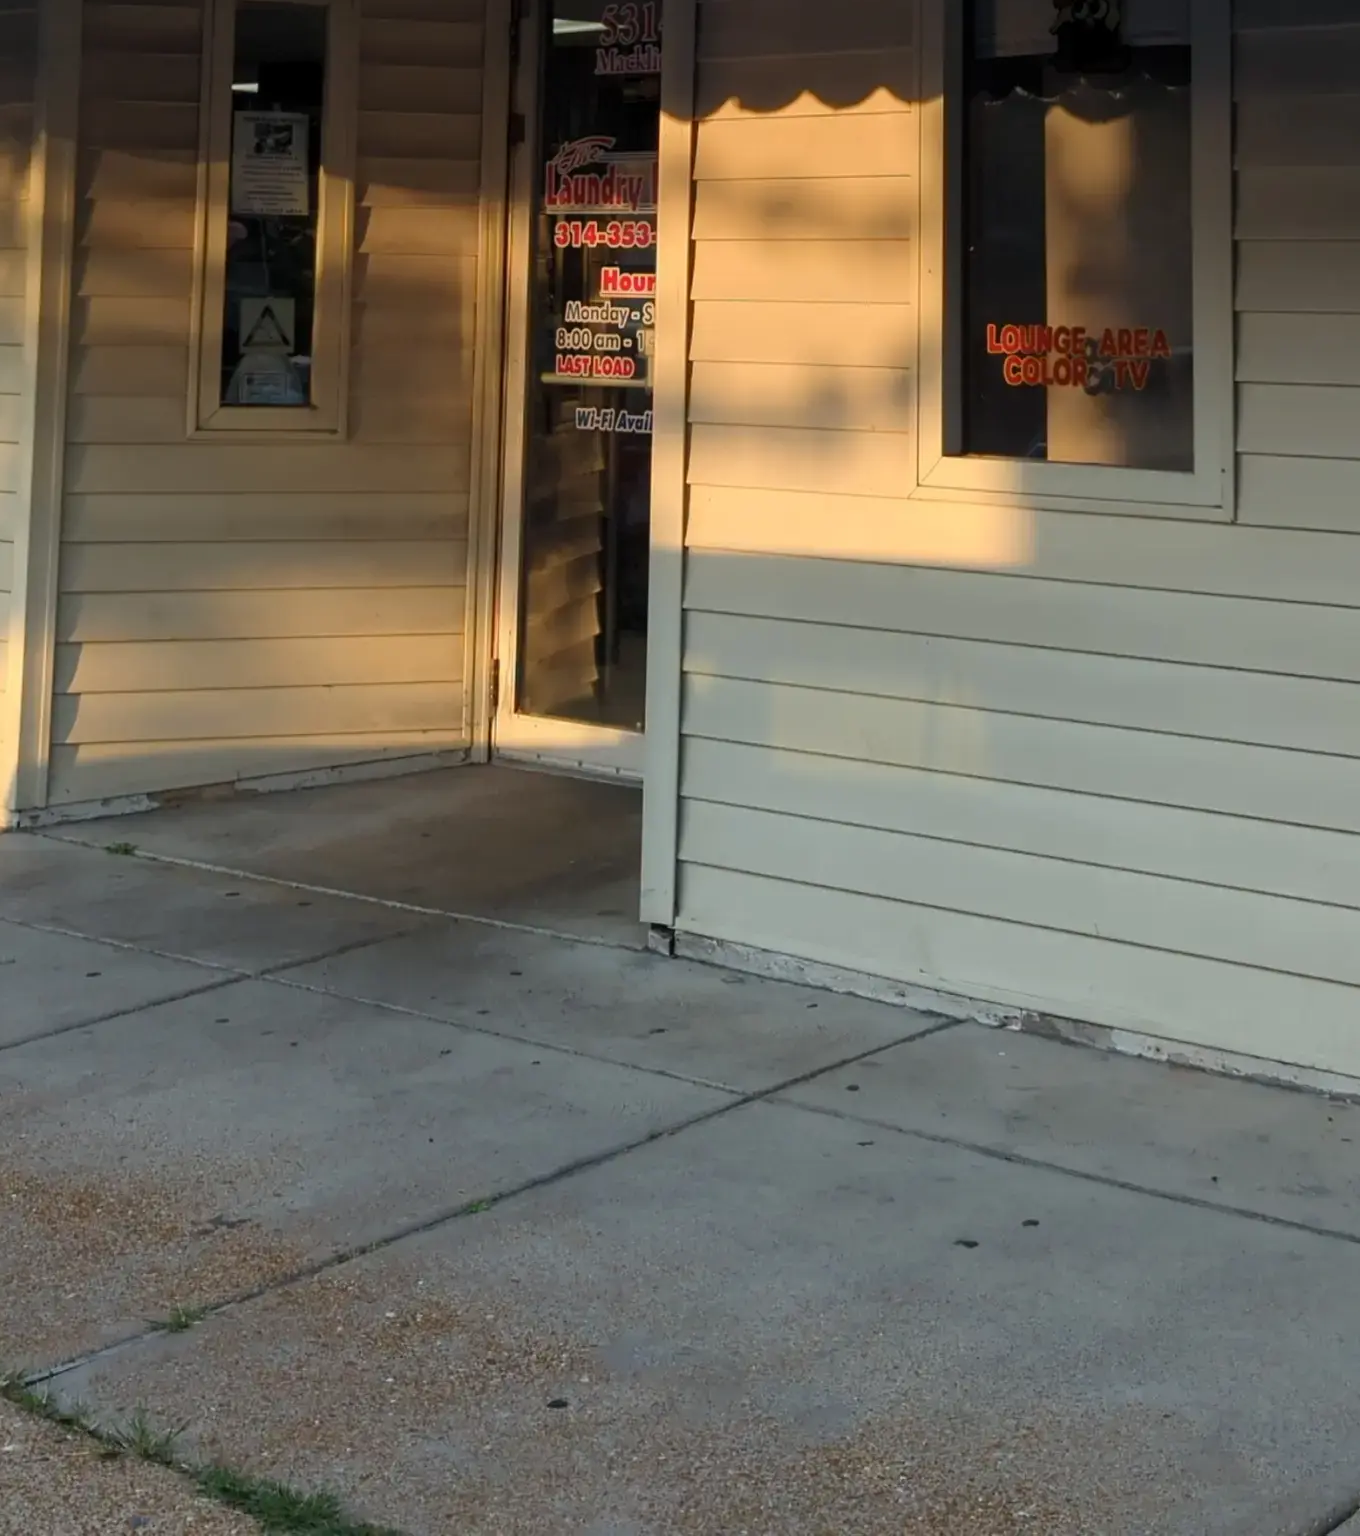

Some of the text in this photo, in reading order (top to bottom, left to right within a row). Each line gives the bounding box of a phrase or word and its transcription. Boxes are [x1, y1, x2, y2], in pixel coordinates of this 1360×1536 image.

[599, 1, 662, 46] 531
[594, 43, 661, 73] Mackli
[546, 162, 643, 212] Laundry
[554, 221, 656, 248] 314-353-
[601, 267, 655, 292] Hour
[565, 301, 629, 328] Monday
[643, 303, 654, 324] S
[555, 328, 592, 350] 8:00
[594, 336, 620, 350] am
[987, 323, 1172, 359] LOUNGE AREA
[556, 353, 635, 377] LAST LOAD
[1003, 355, 1151, 391] COLOR TV
[575, 407, 652, 432] Wi-Fi Avail
